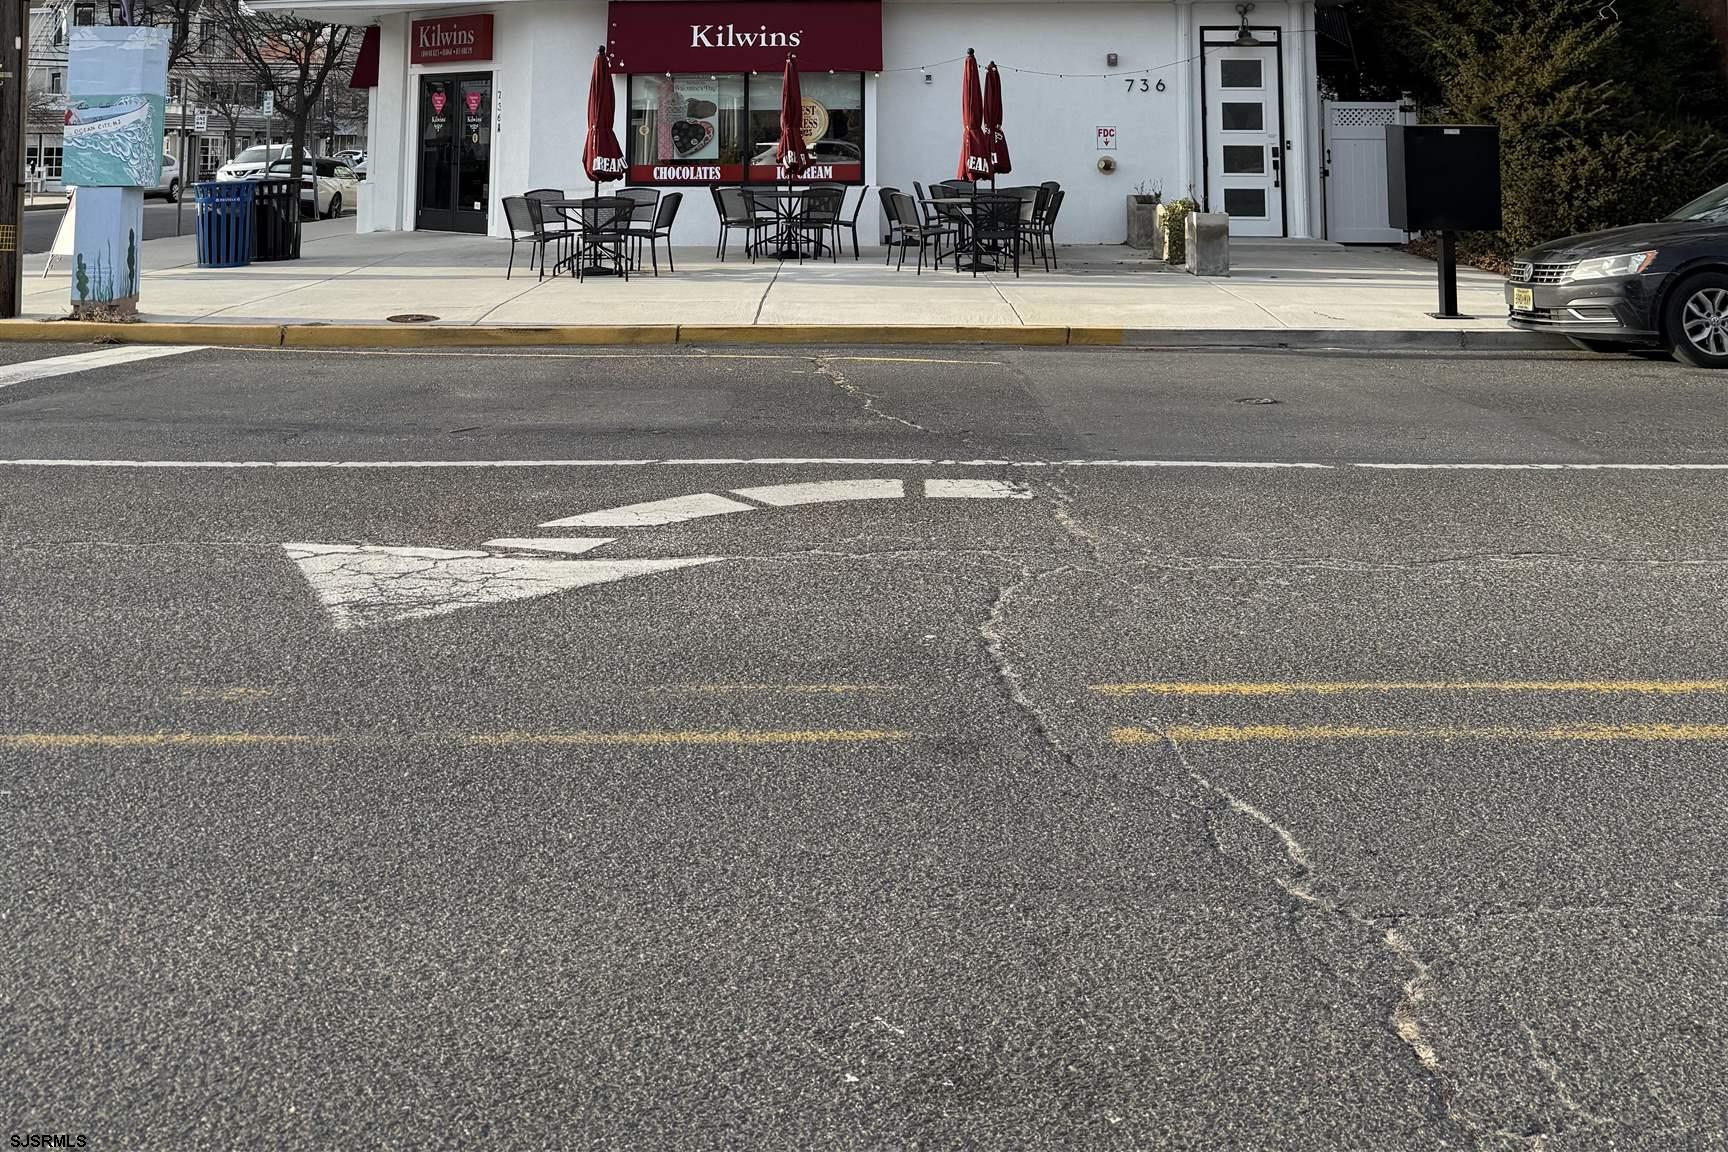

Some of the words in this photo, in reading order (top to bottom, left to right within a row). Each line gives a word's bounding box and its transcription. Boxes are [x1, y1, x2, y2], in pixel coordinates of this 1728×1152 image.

[418, 23, 475, 48] Kilwins
[689, 23, 801, 48] Kilwins
[1124, 78, 1166, 93] 736
[1098, 128, 1115, 138] FDC
[653, 166, 721, 180] CHOCOLATES
